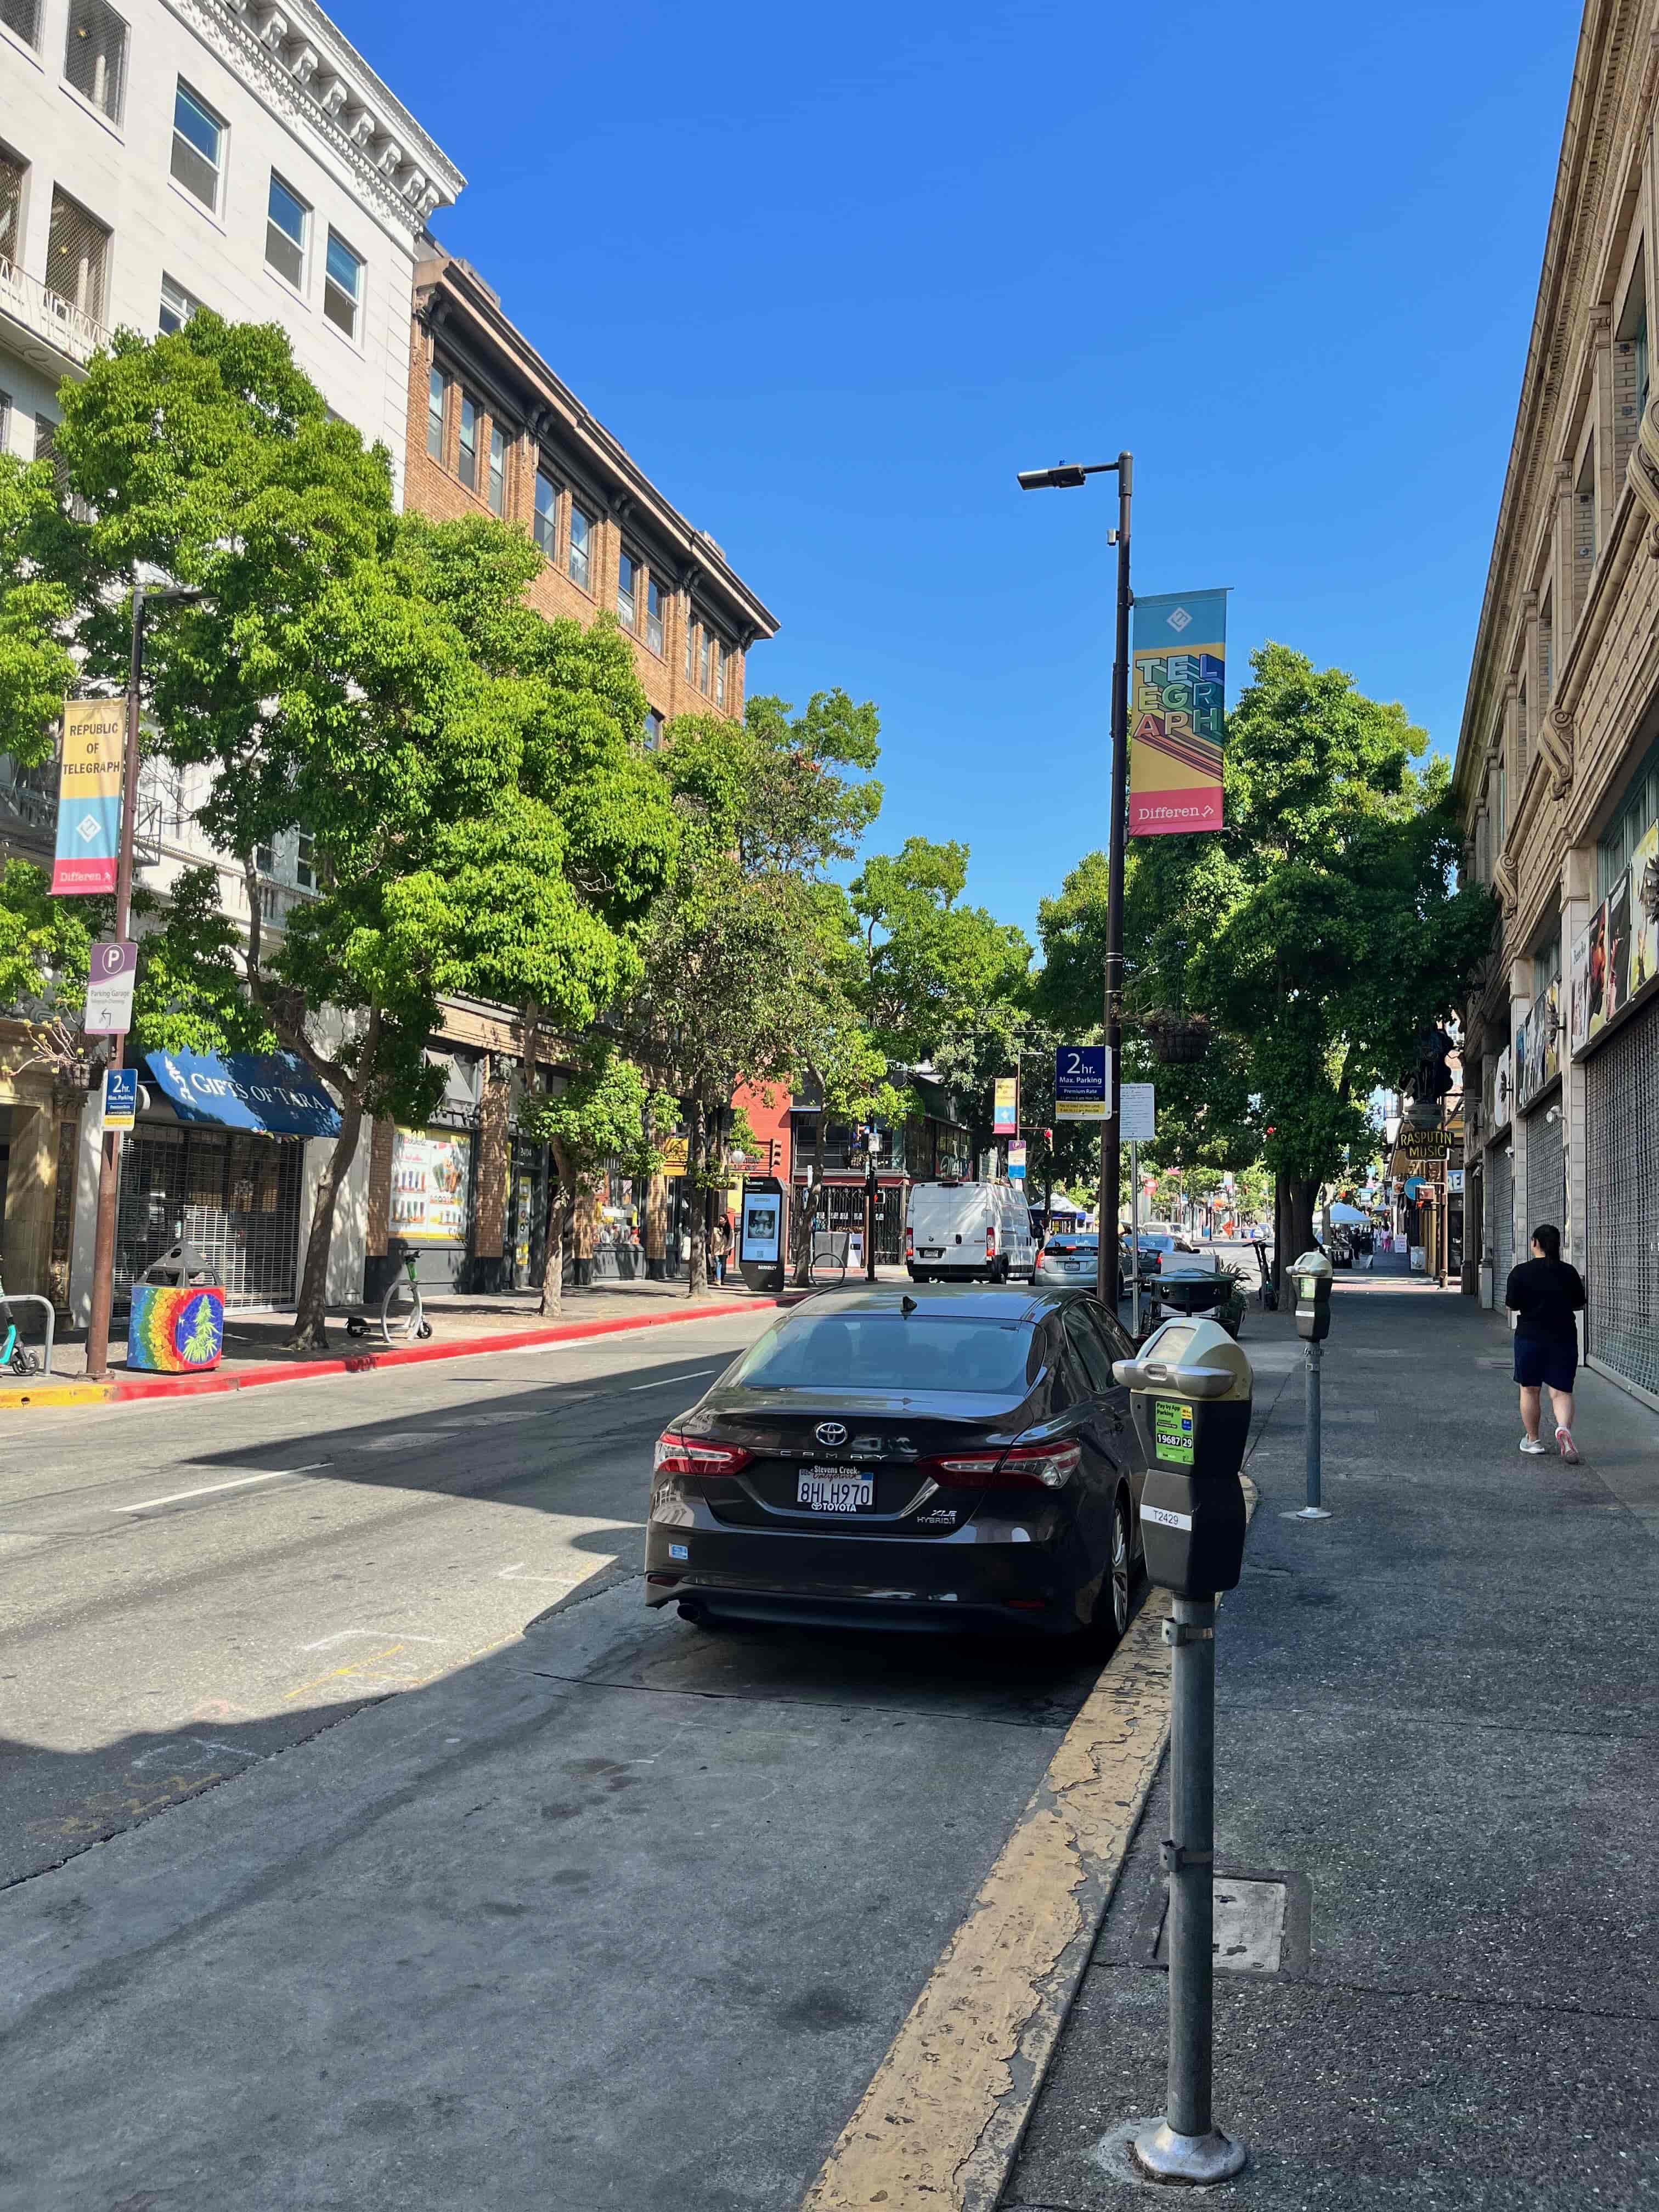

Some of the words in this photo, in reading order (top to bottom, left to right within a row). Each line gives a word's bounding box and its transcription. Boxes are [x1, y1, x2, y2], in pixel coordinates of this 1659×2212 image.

[70, 723, 119, 736] REPUBLIC
[86, 743, 100, 754] OF
[63, 761, 120, 775] TELEGRAPH
[108, 949, 120, 968] P
[91, 990, 111, 998] Parking
[111, 990, 129, 998] Garage
[191, 1073, 249, 1099] GIFTS
[250, 1085, 273, 1103] OF
[273, 1086, 326, 1110] TARA
[1401, 1132, 1452, 1146] RASPUTIN
[1409, 1145, 1446, 1158] MUSIC
[1157, 1409, 1174, 1418] Parking
[1158, 1434, 1181, 1446] 19687
[1183, 1438, 1192, 1447] 29
[814, 1465, 838, 1474] Stevens
[839, 1466, 857, 1475] Creek
[800, 1482, 870, 1505] 8HLH970
[822, 1503, 856, 1512] TOYOTA
[1153, 1510, 1178, 1525] T2429
